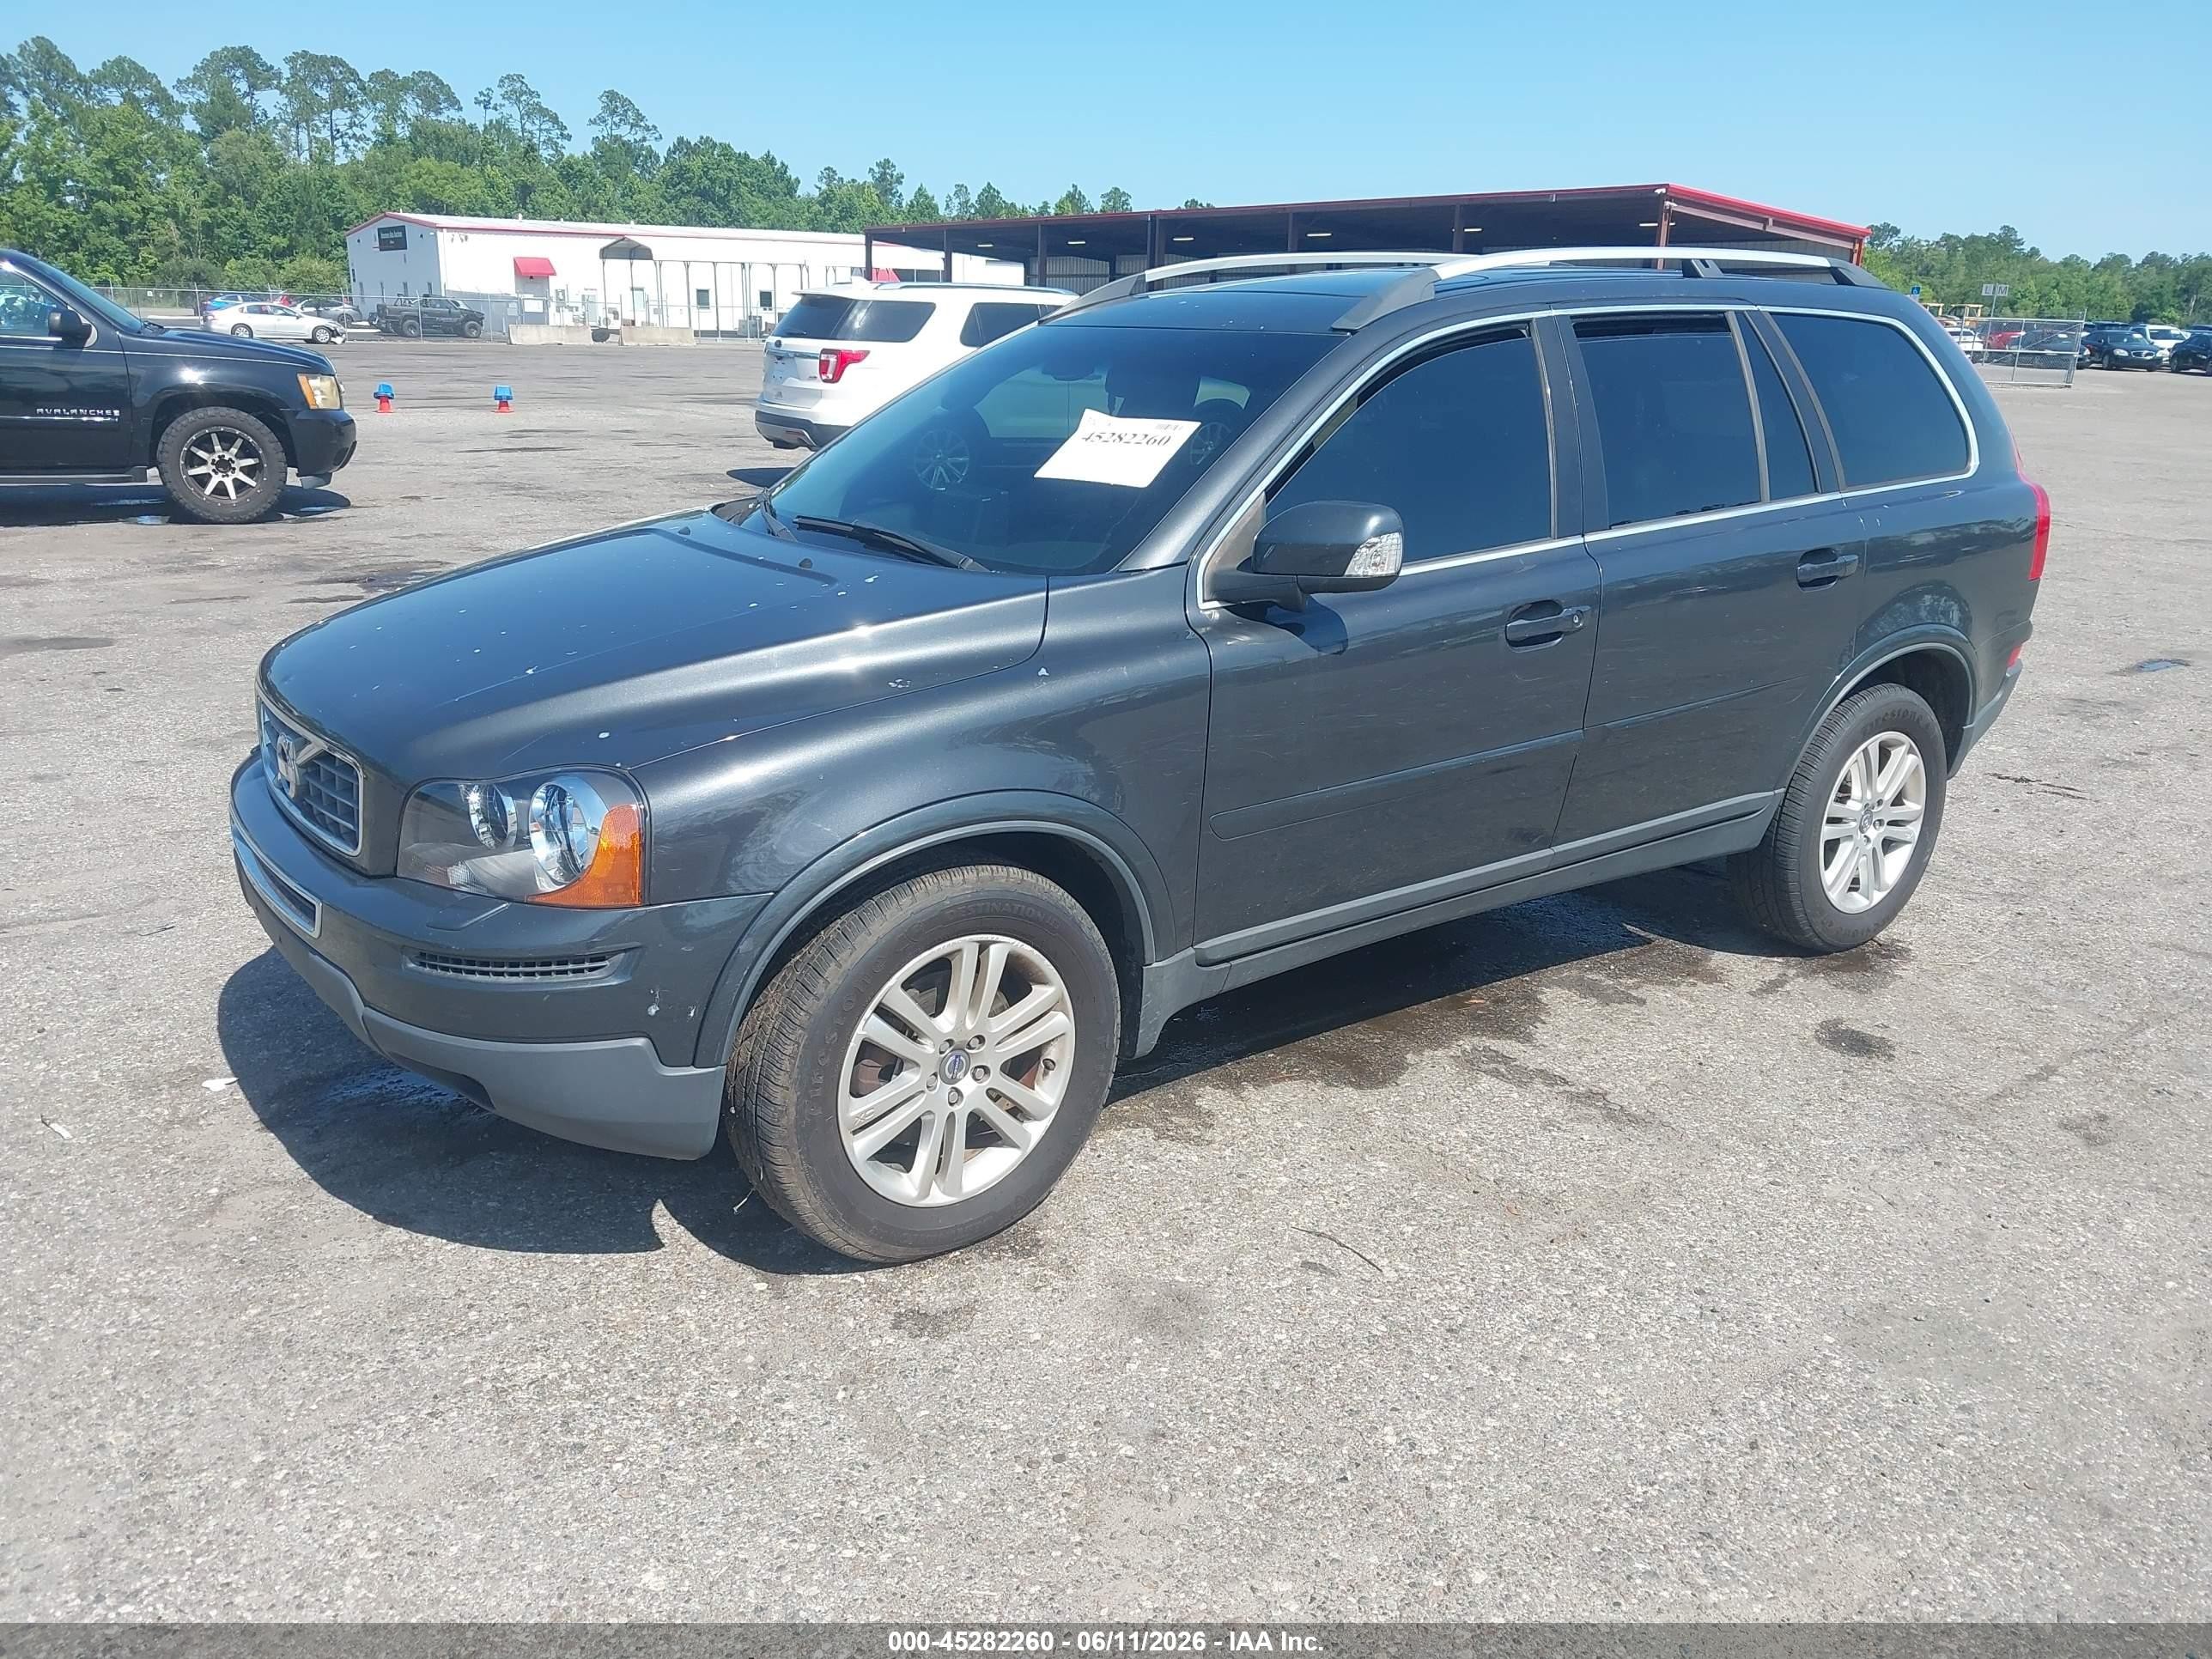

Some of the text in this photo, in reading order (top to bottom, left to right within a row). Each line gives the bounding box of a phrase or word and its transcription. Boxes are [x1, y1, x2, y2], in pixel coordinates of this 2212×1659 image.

[1998, 286, 2008, 295] M
[1082, 432, 1171, 446] 45282260
[852, 1109, 875, 1126] XC
